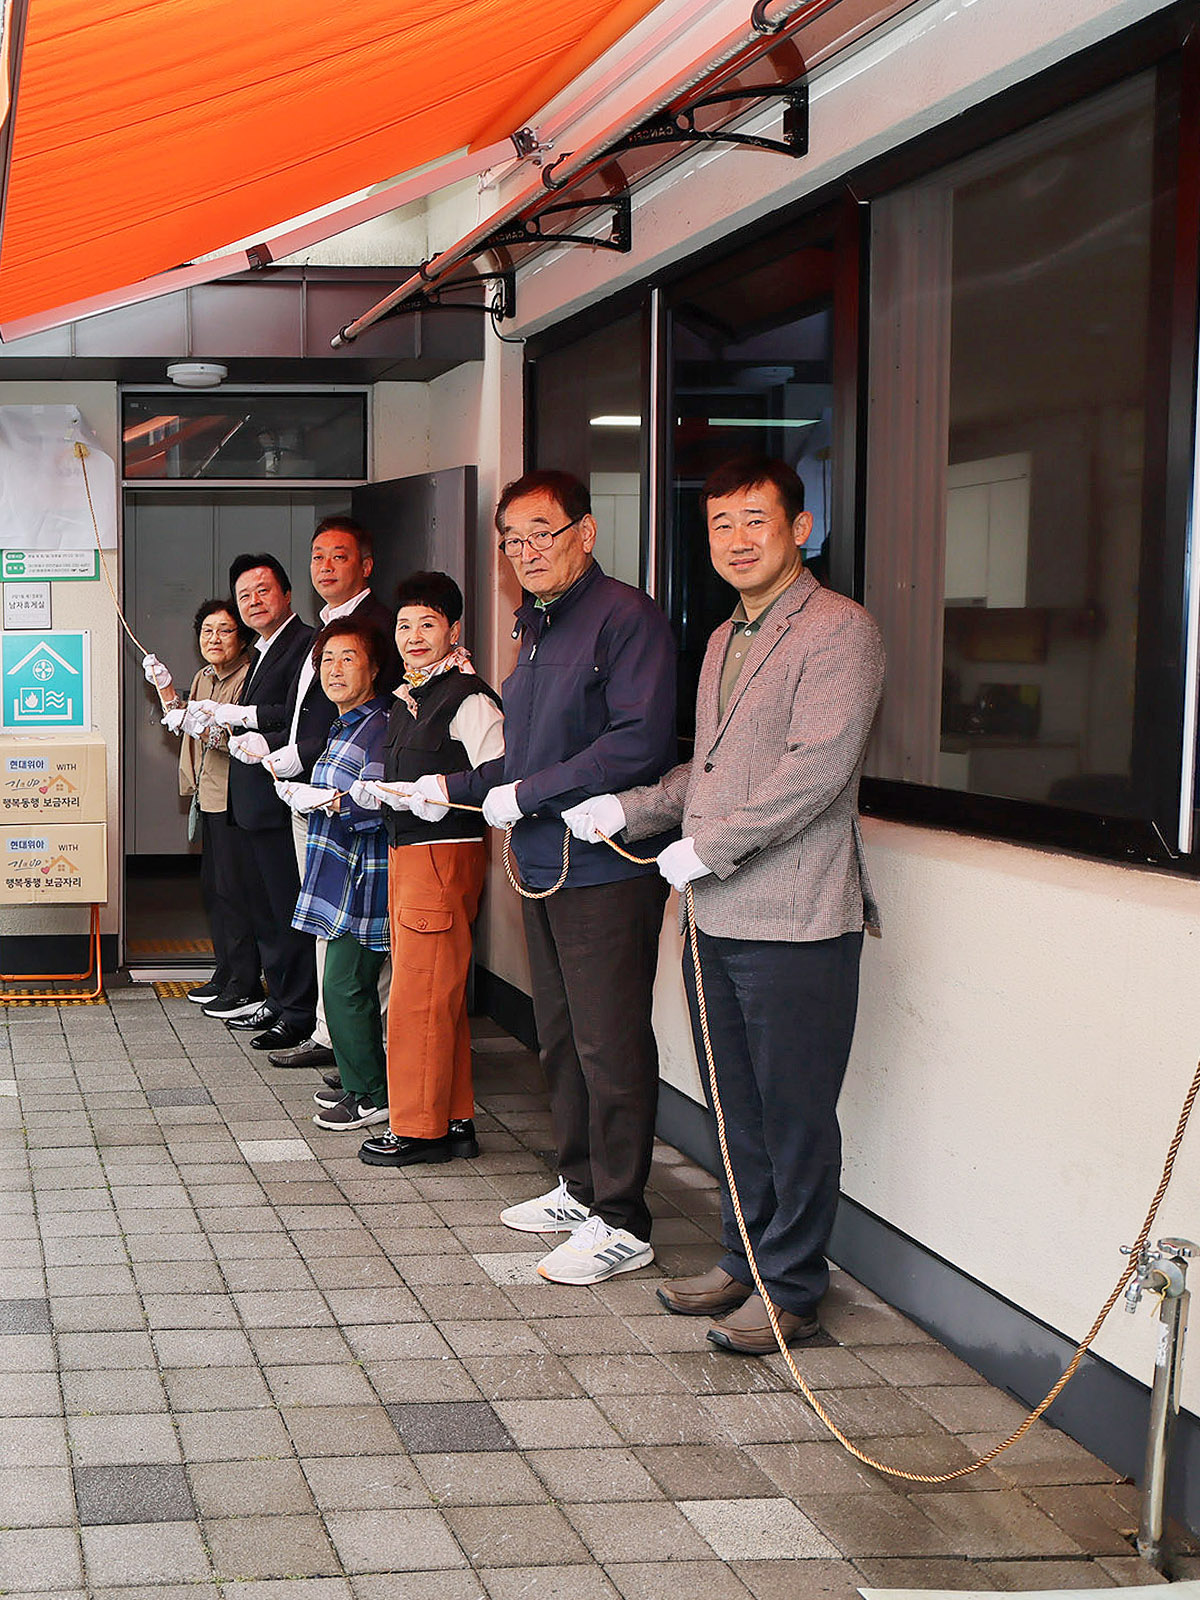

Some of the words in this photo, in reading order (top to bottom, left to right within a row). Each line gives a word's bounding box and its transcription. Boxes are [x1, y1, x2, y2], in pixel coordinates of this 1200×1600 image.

[8, 601, 45, 610] 남자휴게실
[9, 760, 44, 770] 현대위아
[56, 763, 77, 771] WITH
[2, 797, 40, 809] 행복동행
[43, 797, 80, 808] 보금자리
[10, 840, 44, 850] 현대위아
[58, 844, 79, 852] WITH
[5, 877, 41, 889] 행복동행
[45, 877, 82, 888] 보금자리
